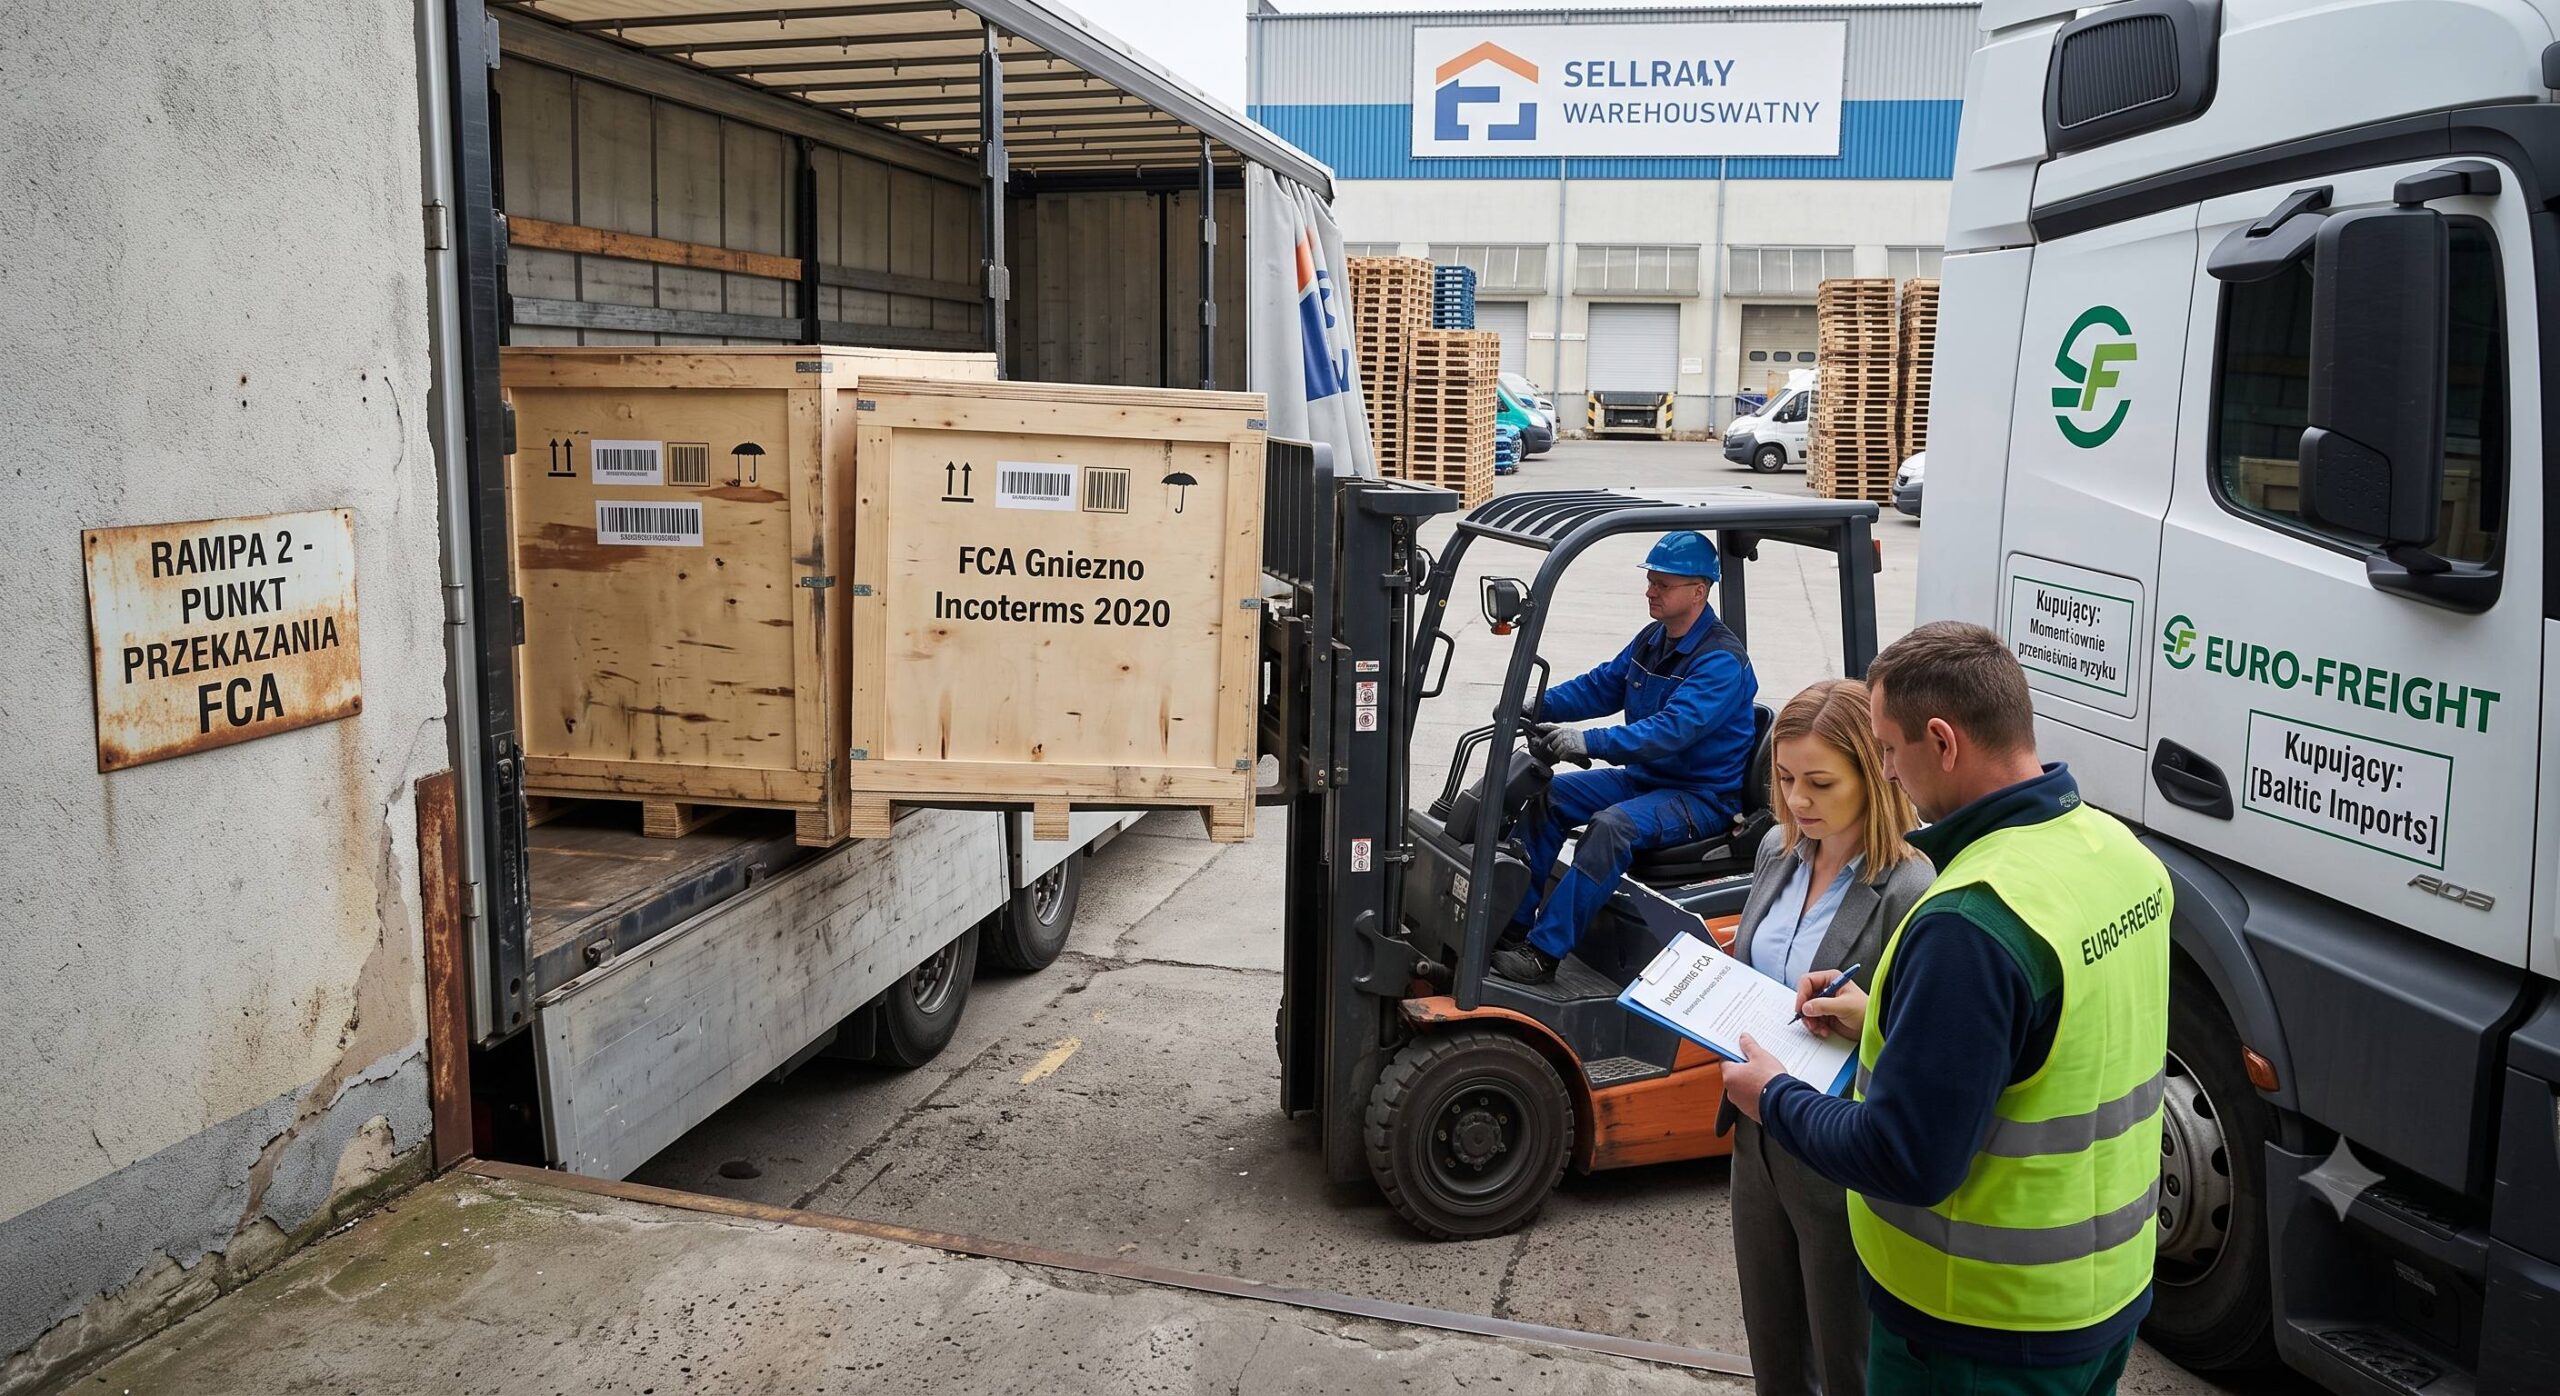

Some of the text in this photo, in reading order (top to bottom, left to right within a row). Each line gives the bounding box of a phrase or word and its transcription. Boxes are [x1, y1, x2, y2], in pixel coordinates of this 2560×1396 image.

[1563, 101, 1820, 124] WAREHOUSWATNY
[151, 532, 268, 578] RAMPA
[276, 530, 293, 564] 2
[959, 546, 1145, 582] FCA Gniezno
[181, 577, 286, 625] PUNKT
[934, 590, 1171, 628] Incoterms 2020
[2036, 588, 2102, 628] Kupujący:
[123, 616, 340, 684] PRZEKAZANIA
[197, 672, 285, 734] FCA
[2205, 634, 2501, 734] EURO-FREIGHT
[2284, 730, 2404, 791] Kupujący:
[2249, 765, 2440, 857] [Baltic Imports]
